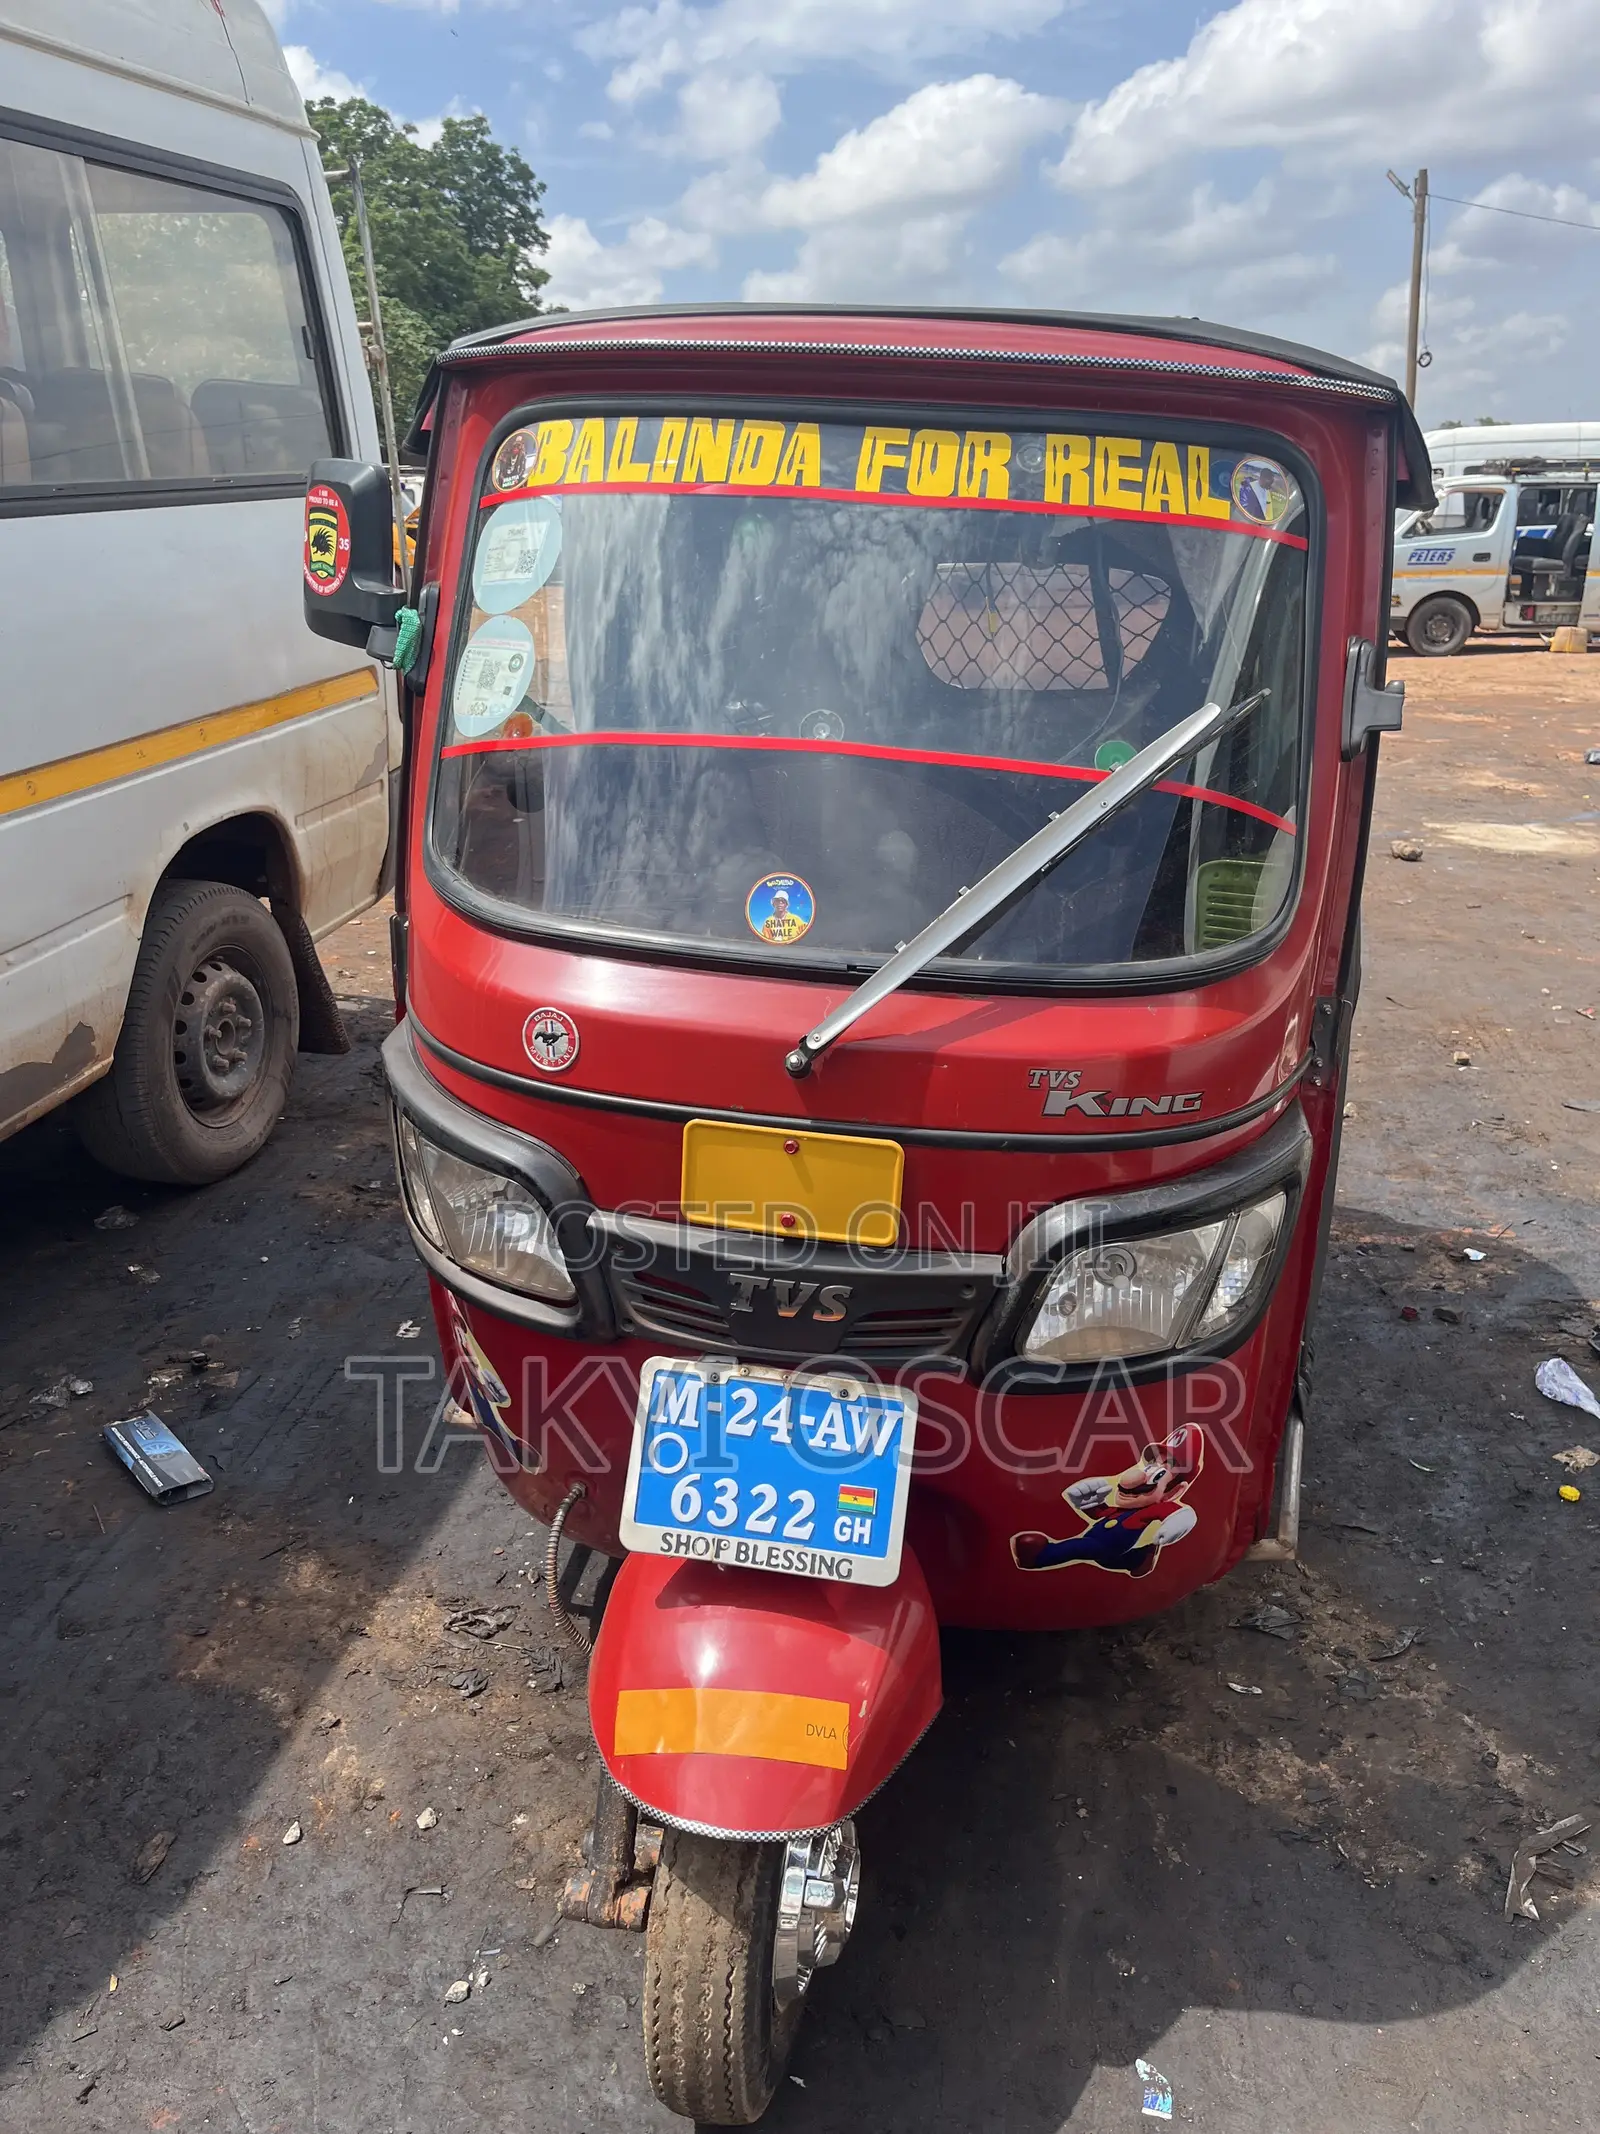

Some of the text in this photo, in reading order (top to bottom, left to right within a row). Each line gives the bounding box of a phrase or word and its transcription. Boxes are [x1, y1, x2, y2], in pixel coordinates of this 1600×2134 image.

[527, 417, 1230, 519] BALINDA FOR REAL
[339, 538, 350, 551] 35
[1408, 548, 1455, 563] PETERS
[765, 919, 796, 928] SHATTA
[770, 928, 793, 937] WALE
[534, 1011, 564, 1022] BAJAJ
[529, 1045, 574, 1067] MUSTANG
[1028, 1069, 1082, 1088] TVS
[1042, 1091, 1205, 1116] KING
[728, 1273, 853, 1322] TVS
[650, 1375, 904, 1457] M-24-AW
[670, 1473, 873, 1545] 6322 GH
[660, 1532, 853, 1580] SHOP BLESSING
[806, 1723, 837, 1740] DVLA
